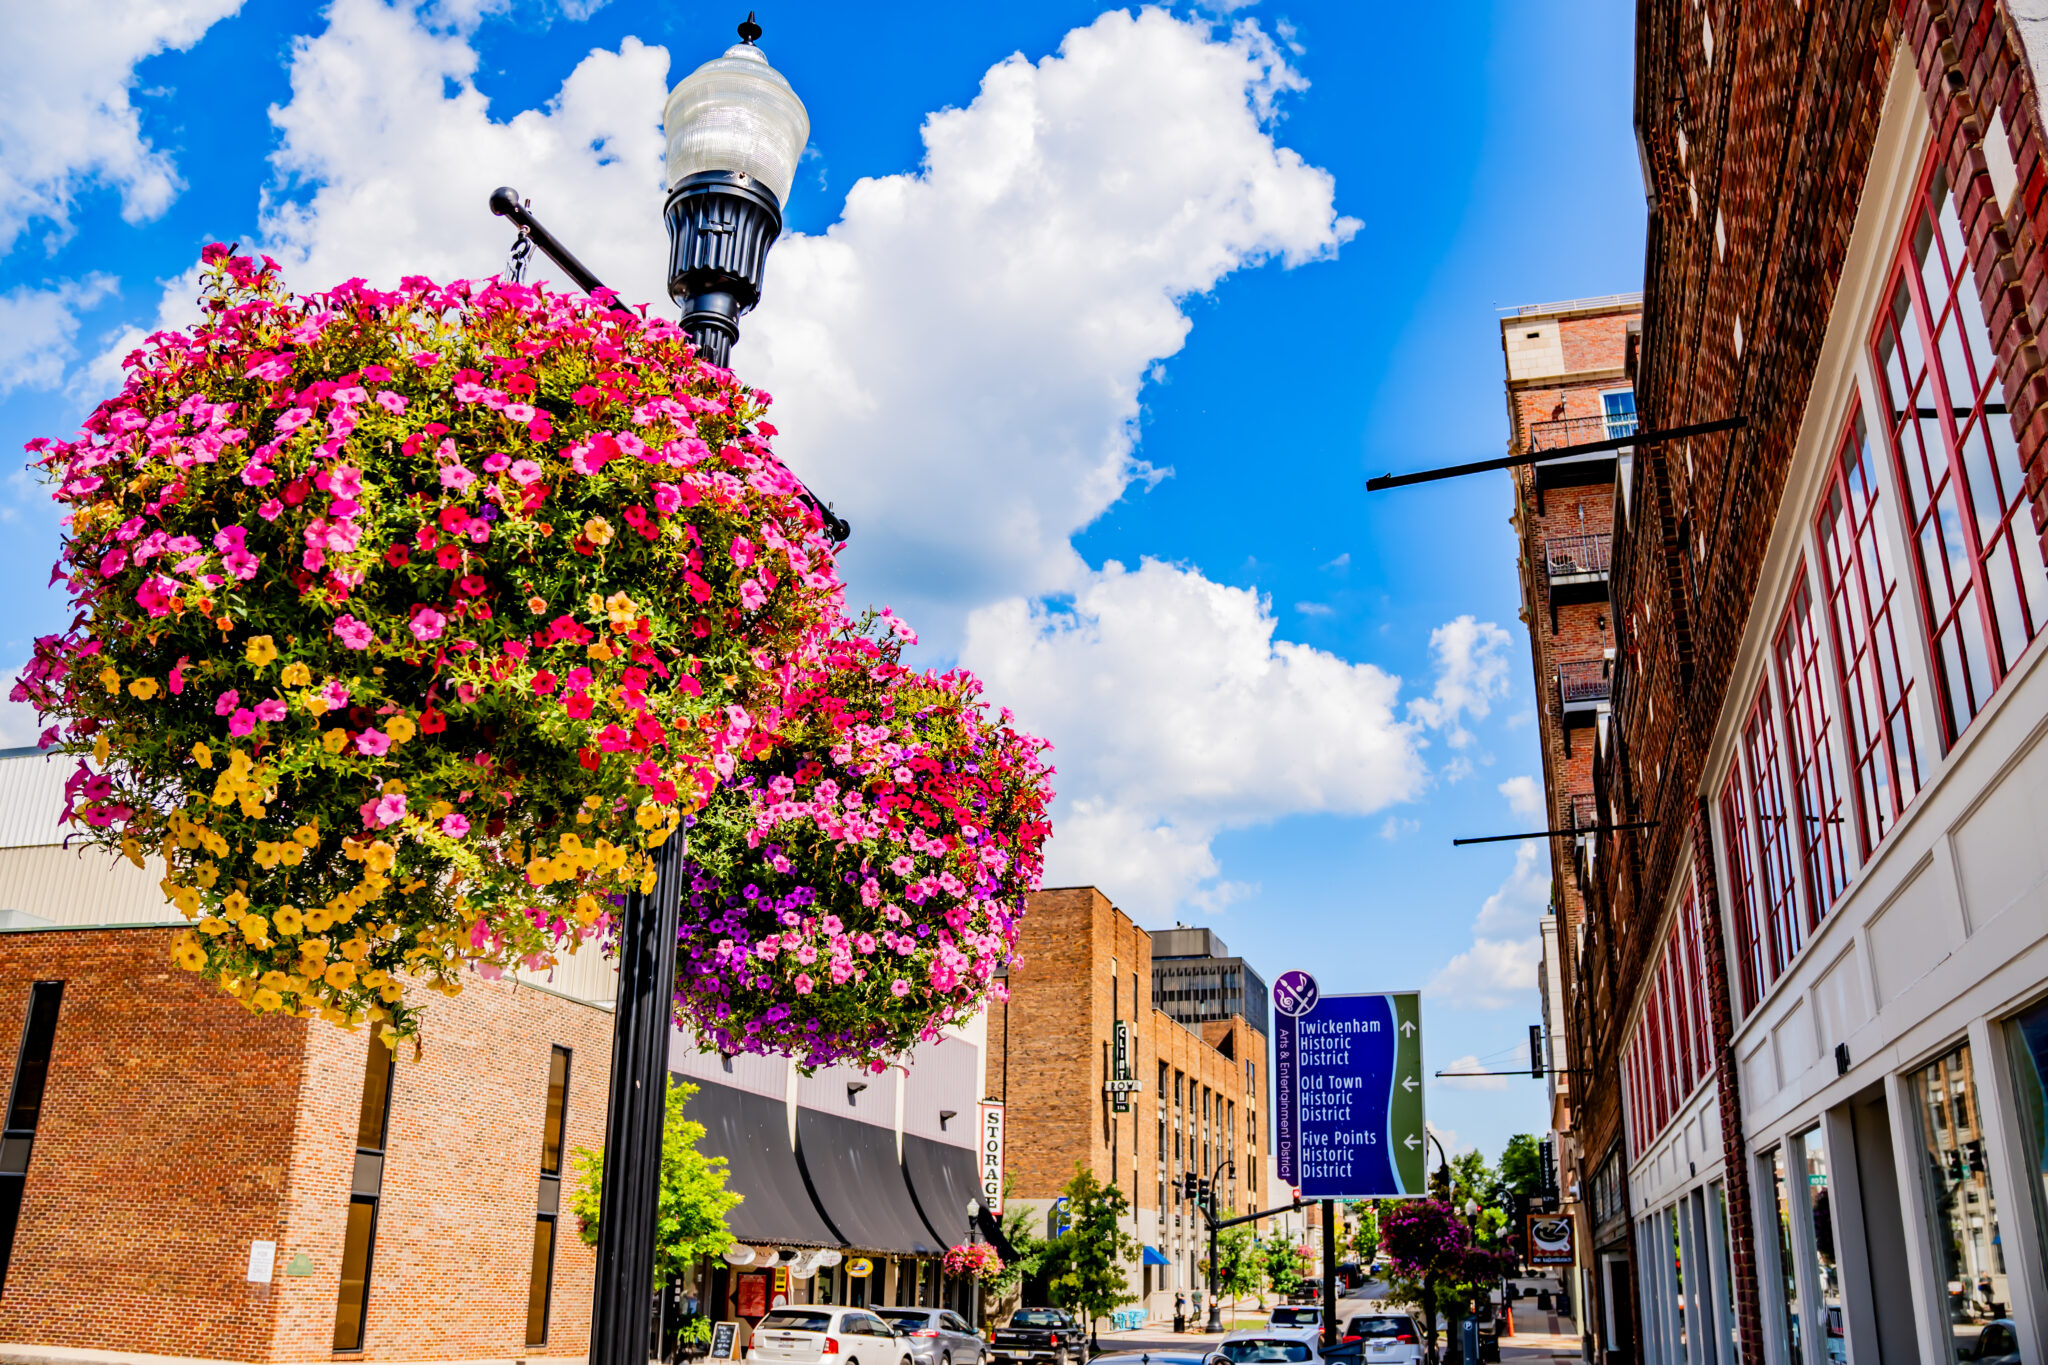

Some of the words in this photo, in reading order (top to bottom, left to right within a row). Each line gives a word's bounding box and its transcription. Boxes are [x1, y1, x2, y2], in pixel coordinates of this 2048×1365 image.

[1300, 1018, 1380, 1034] Twickenham
[1280, 1029, 1289, 1049] Arts
[1301, 1035, 1351, 1050] Historic
[1280, 1051, 1290, 1060] &
[1301, 1050, 1349, 1066] District
[1111, 1082, 1134, 1090] ROW
[1301, 1075, 1323, 1090] Old
[1328, 1075, 1362, 1090] Town
[1280, 1063, 1290, 1138] Entertainment
[1302, 1090, 1353, 1105] Historic
[1302, 1106, 1350, 1121] District
[1302, 1131, 1328, 1146] Five
[1334, 1130, 1377, 1145] Points
[984, 1112, 999, 1209] STORAGE
[1280, 1141, 1291, 1177] District
[1303, 1146, 1354, 1162] Historic
[1303, 1162, 1352, 1178] District
